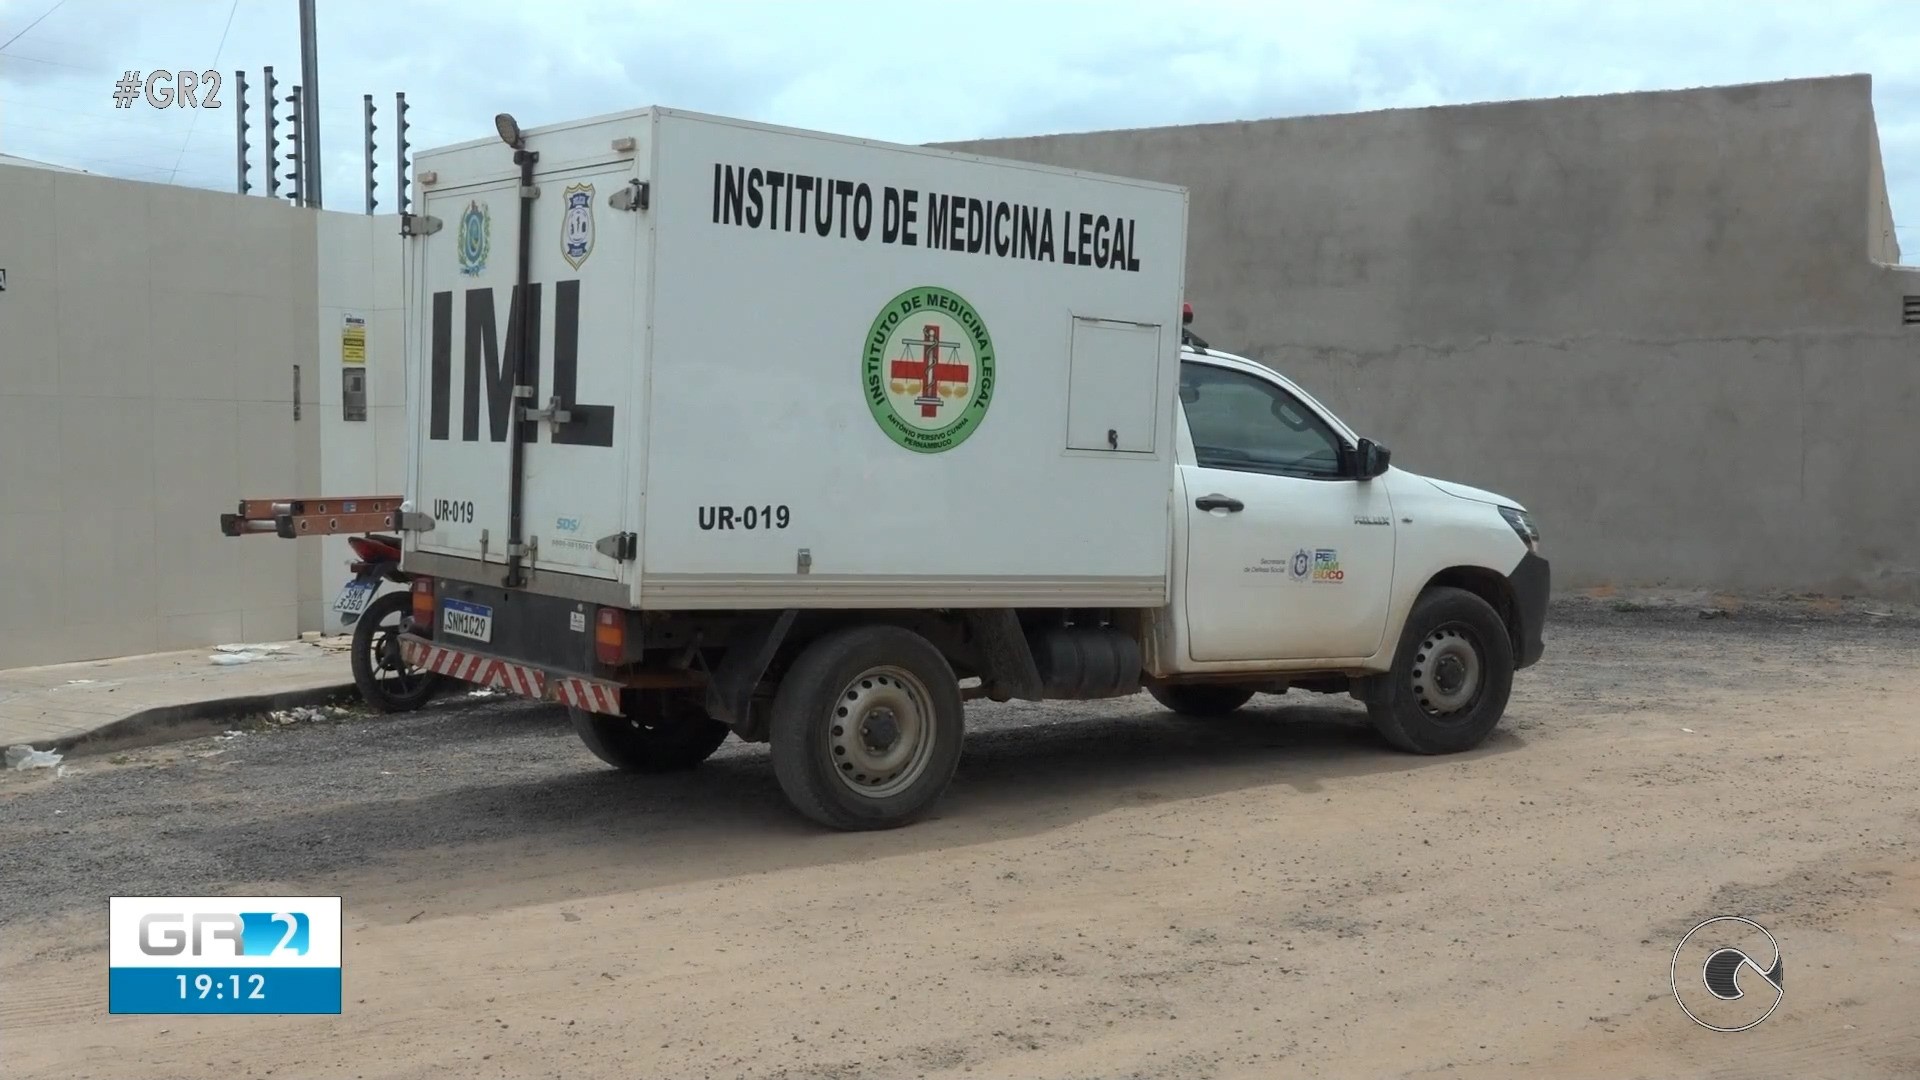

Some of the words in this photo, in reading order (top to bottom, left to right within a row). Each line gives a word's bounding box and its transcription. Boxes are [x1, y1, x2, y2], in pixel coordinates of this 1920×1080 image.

[713, 163, 872, 241] INSTITUTO
[882, 186, 918, 246] DE
[927, 192, 1055, 262] MEDICINA
[1063, 210, 1140, 272] LEGAL
[430, 279, 614, 447] IML
[868, 311, 899, 405] INSTITUTO
[901, 295, 922, 314] DE
[927, 293, 988, 351] MEDICINA
[974, 356, 992, 409] LEGAL
[904, 437, 952, 449] PERNAMBUCO
[434, 499, 474, 523] UR-019
[699, 504, 790, 530] UR-019
[345, 588, 365, 600] SNR
[447, 611, 486, 638] SNM1C29
